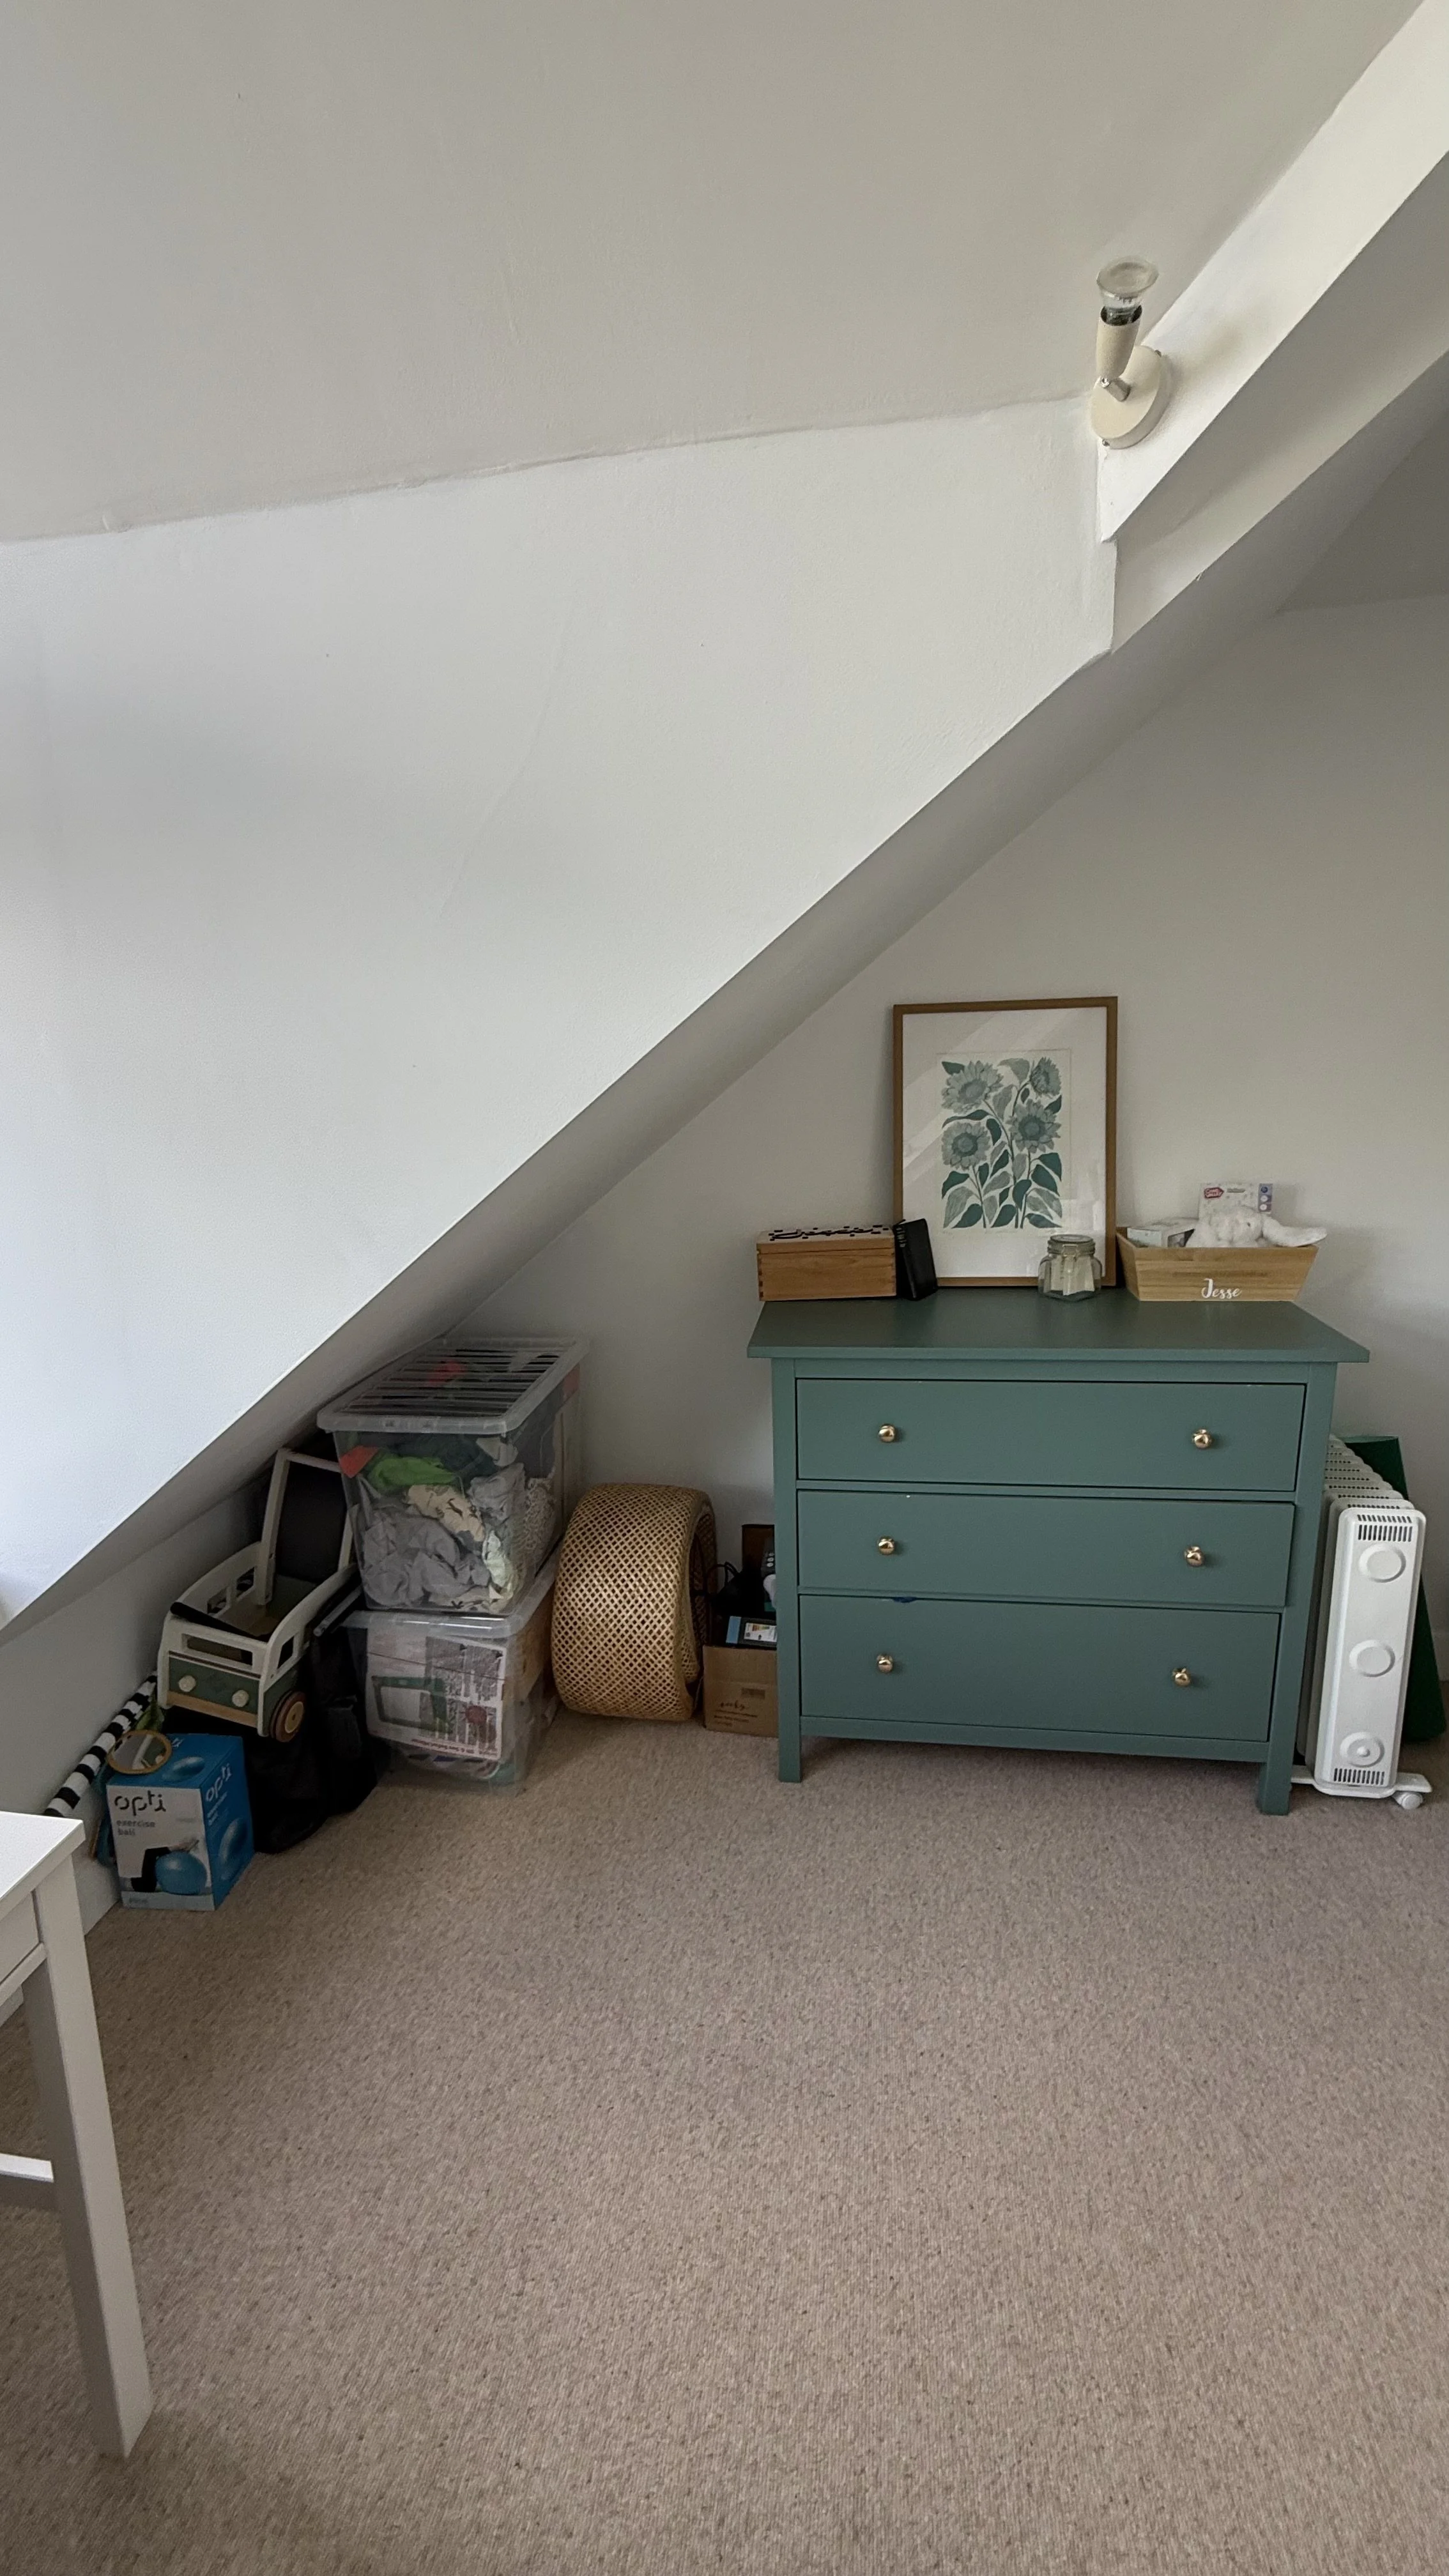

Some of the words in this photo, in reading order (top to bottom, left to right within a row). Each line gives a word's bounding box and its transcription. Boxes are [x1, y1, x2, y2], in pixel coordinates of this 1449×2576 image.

[1201, 1277, 1243, 1299] Jesse
[206, 1763, 233, 1802] opti
[114, 1790, 166, 1816] opti
